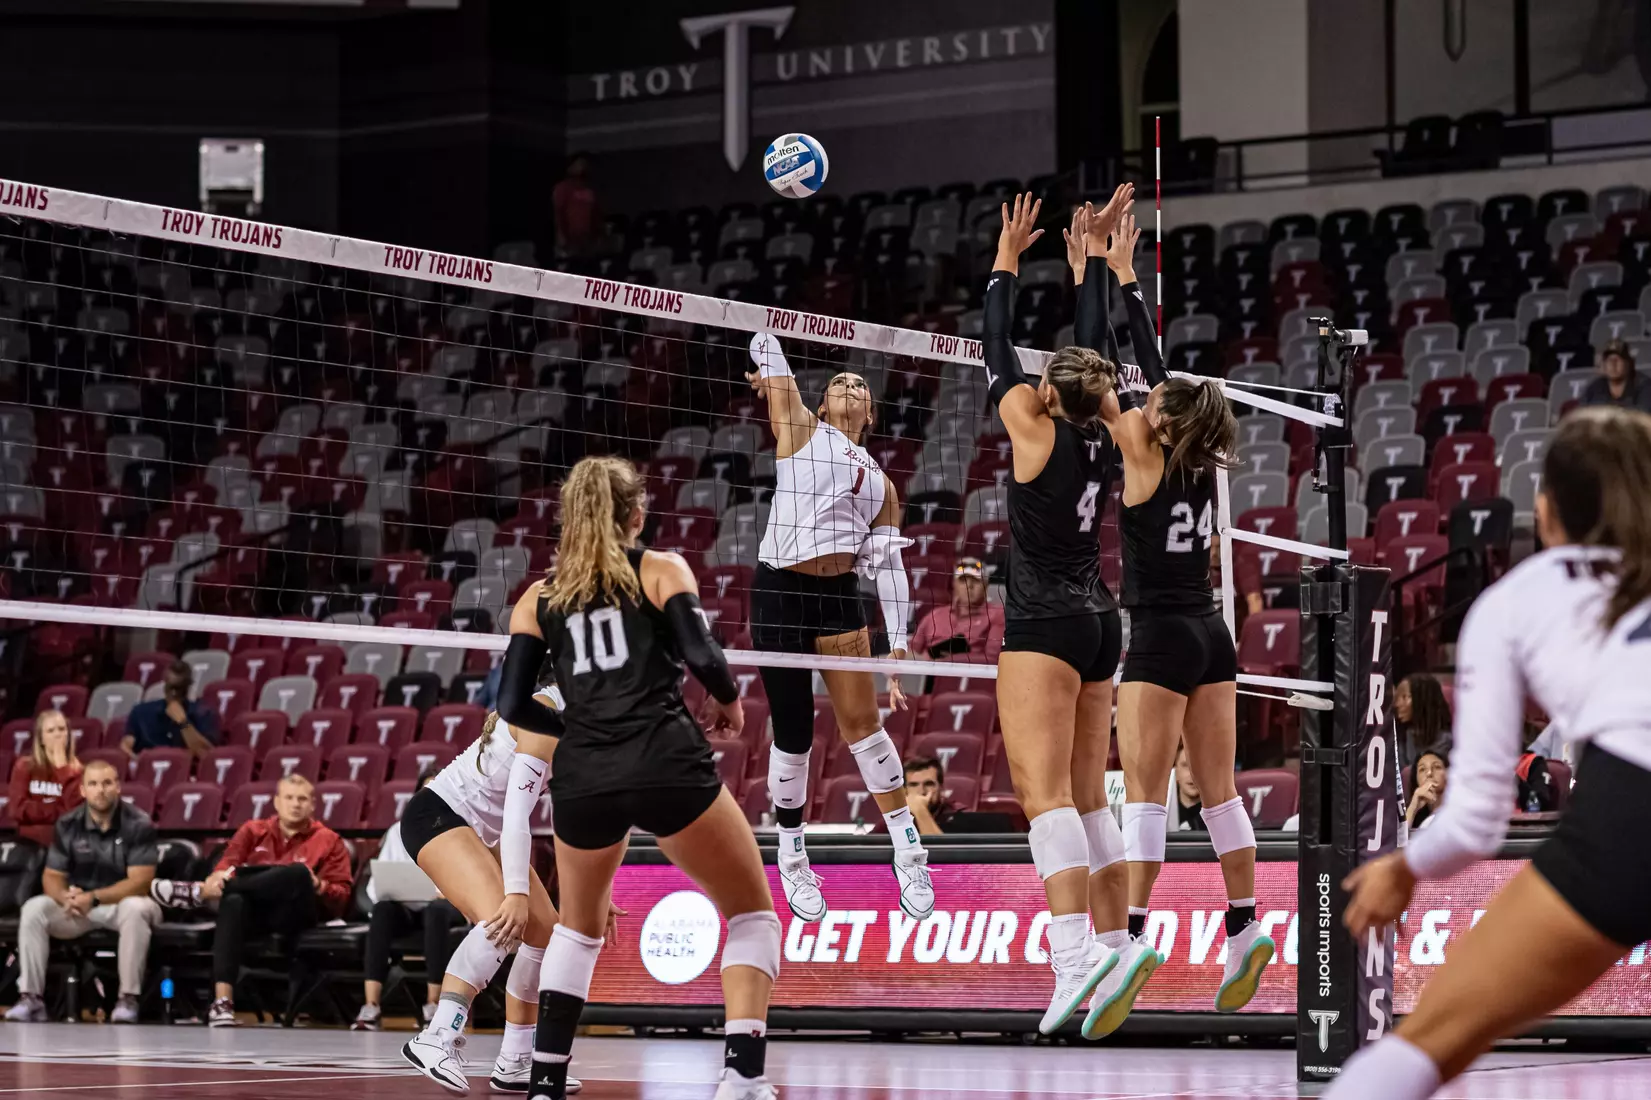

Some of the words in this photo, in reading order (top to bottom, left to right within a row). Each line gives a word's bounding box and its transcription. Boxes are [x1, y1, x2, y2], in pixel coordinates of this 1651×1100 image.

[591, 64, 699, 100] TROY
[776, 23, 1052, 81] UNIVERSITY
[768, 146, 799, 166] molten
[0, 182, 49, 211] JANS
[162, 209, 205, 236] TROY
[211, 217, 282, 249] TROJANS
[384, 246, 424, 272] TROY
[428, 252, 493, 283] TROJANS
[583, 278, 620, 305] TROY
[624, 284, 683, 314] TROJANS
[766, 308, 798, 331] TROY
[802, 314, 856, 341] TROJANS
[930, 334, 961, 356] TROY
[851, 466, 865, 495] 1
[1076, 481, 1101, 532] 4
[1166, 499, 1212, 552] 24
[565, 606, 629, 676] 10
[1366, 610, 1388, 1040] TROJNS
[1317, 873, 1332, 926] sports
[647, 946, 695, 957] HEALTH
[649, 932, 694, 944] PUBLIC
[784, 910, 878, 962] GET
[886, 911, 1019, 963] YOUR
[1317, 930, 1332, 997] imports
